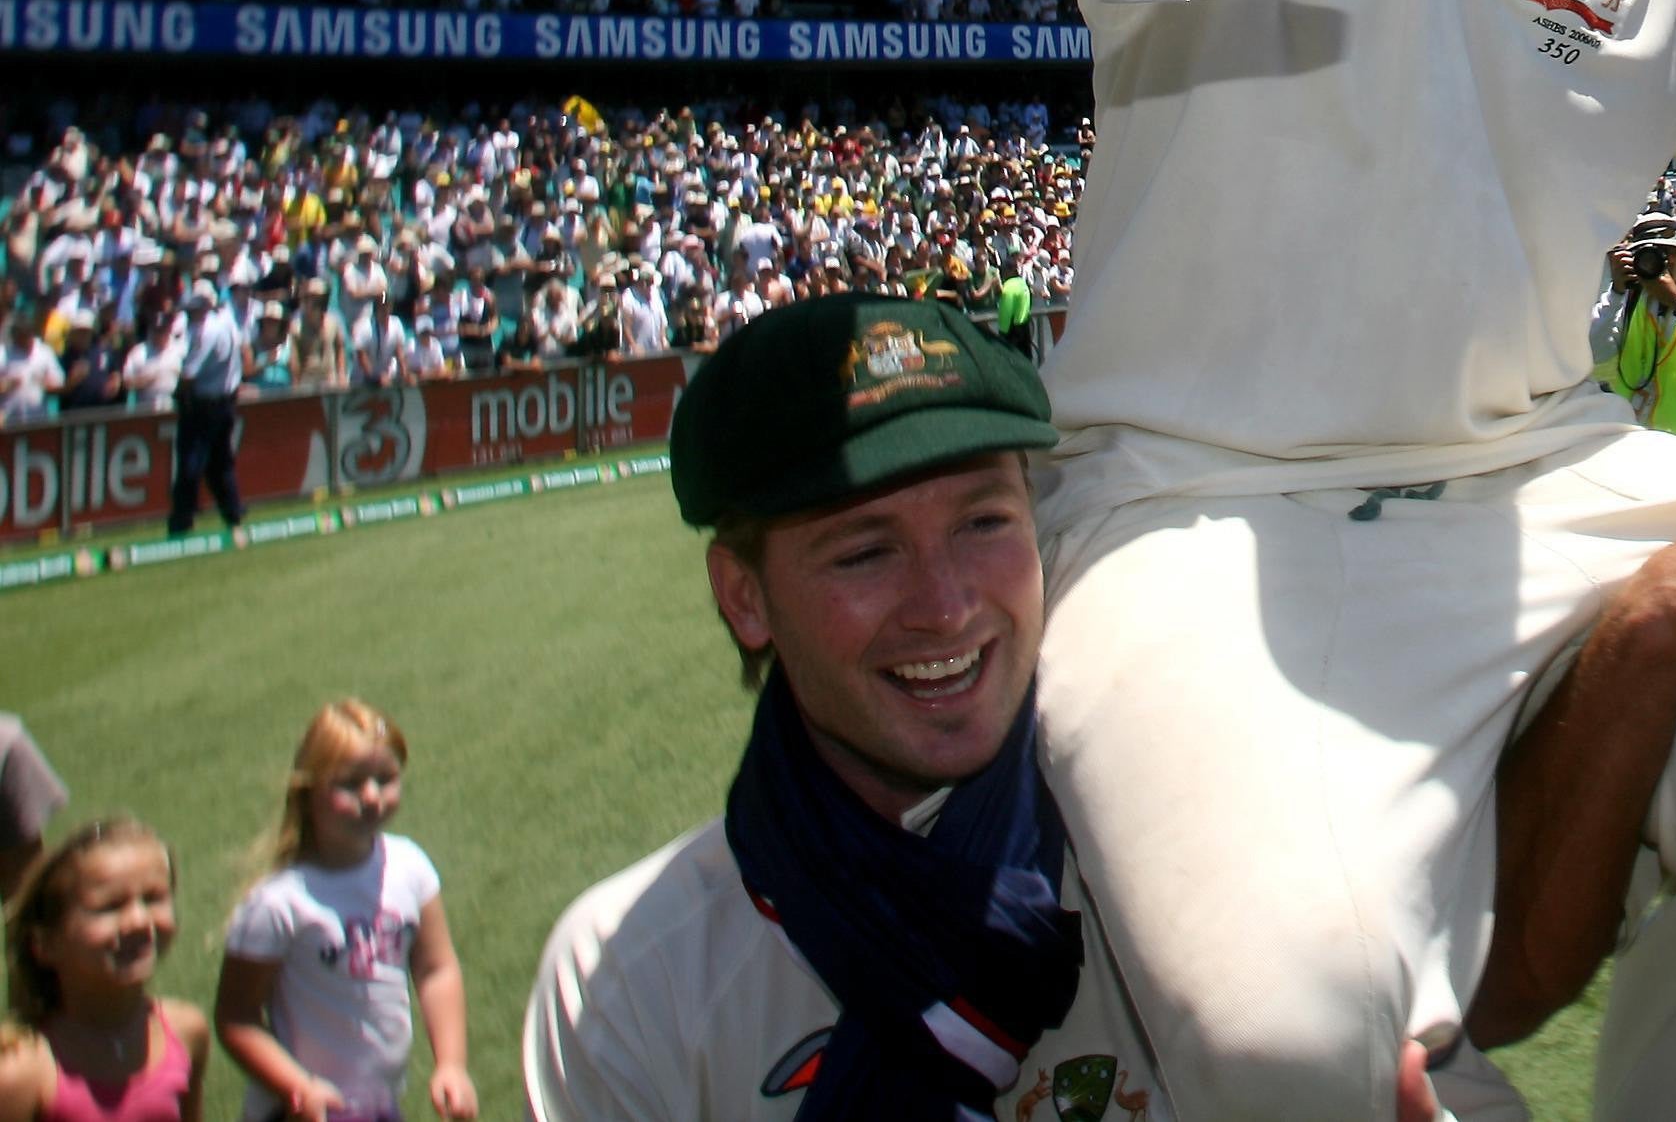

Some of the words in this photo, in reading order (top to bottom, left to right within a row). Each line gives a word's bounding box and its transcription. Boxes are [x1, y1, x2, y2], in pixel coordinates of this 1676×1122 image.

[236, 5, 502, 56] SAMSUNG
[535, 16, 761, 59] SAMSUNG
[789, 22, 986, 59] SAMSUNG
[1532, 16, 1568, 35] ASHES
[1537, 38, 1581, 65] 350
[471, 366, 635, 445] mobile
[0, 421, 150, 528] bile
